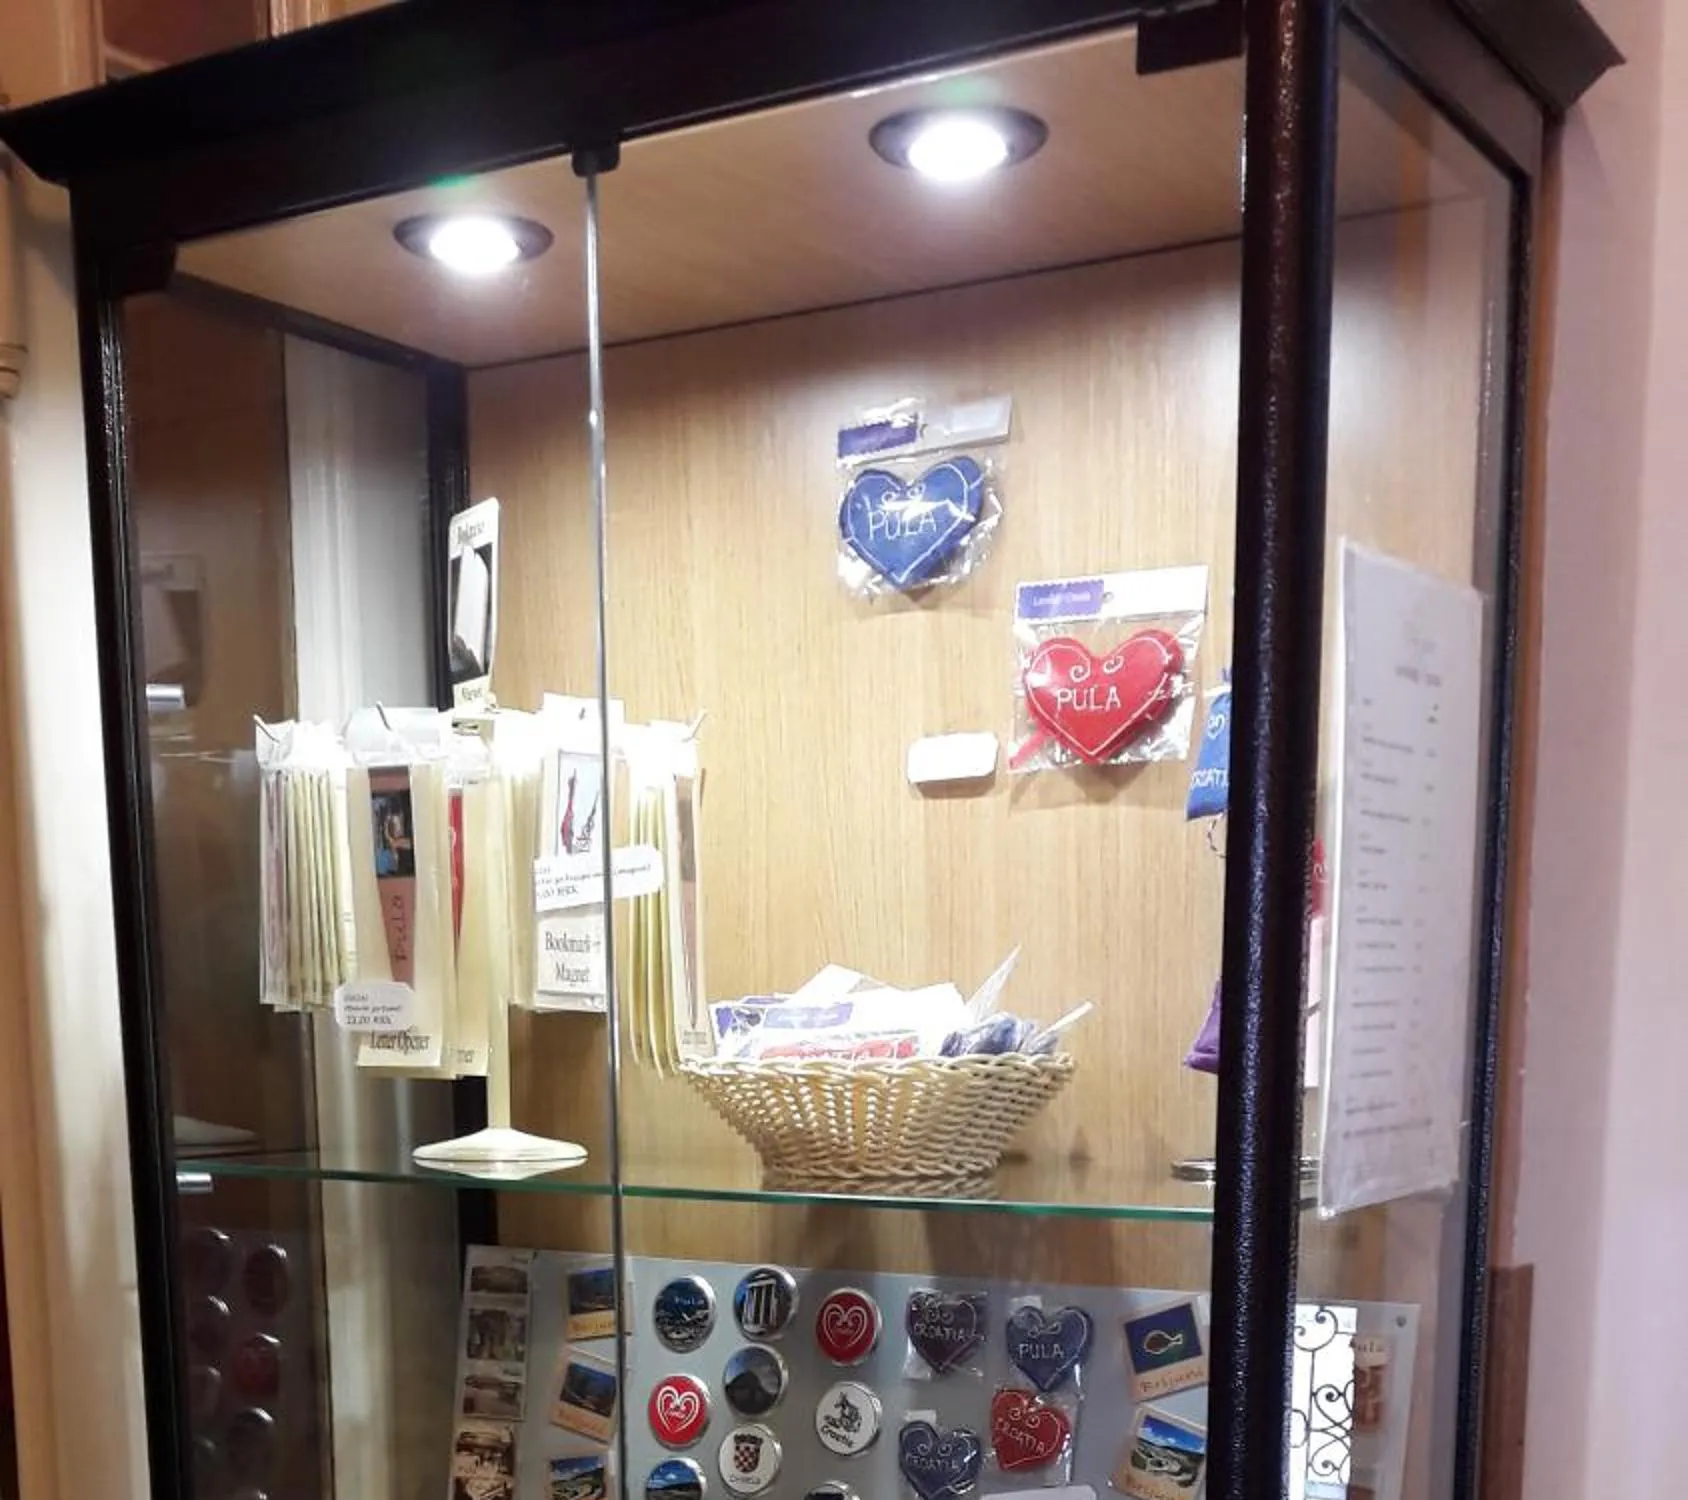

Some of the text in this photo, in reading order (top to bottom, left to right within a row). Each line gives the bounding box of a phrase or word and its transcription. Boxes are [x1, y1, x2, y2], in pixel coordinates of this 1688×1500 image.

[868, 508, 937, 541] PULA
[1055, 686, 1121, 713] PULA
[544, 931, 591, 953] Bookmark
[913, 1321, 965, 1342] CROATIA
[1018, 1342, 1065, 1360] PULA
[994, 1418, 1046, 1452] CROATIA
